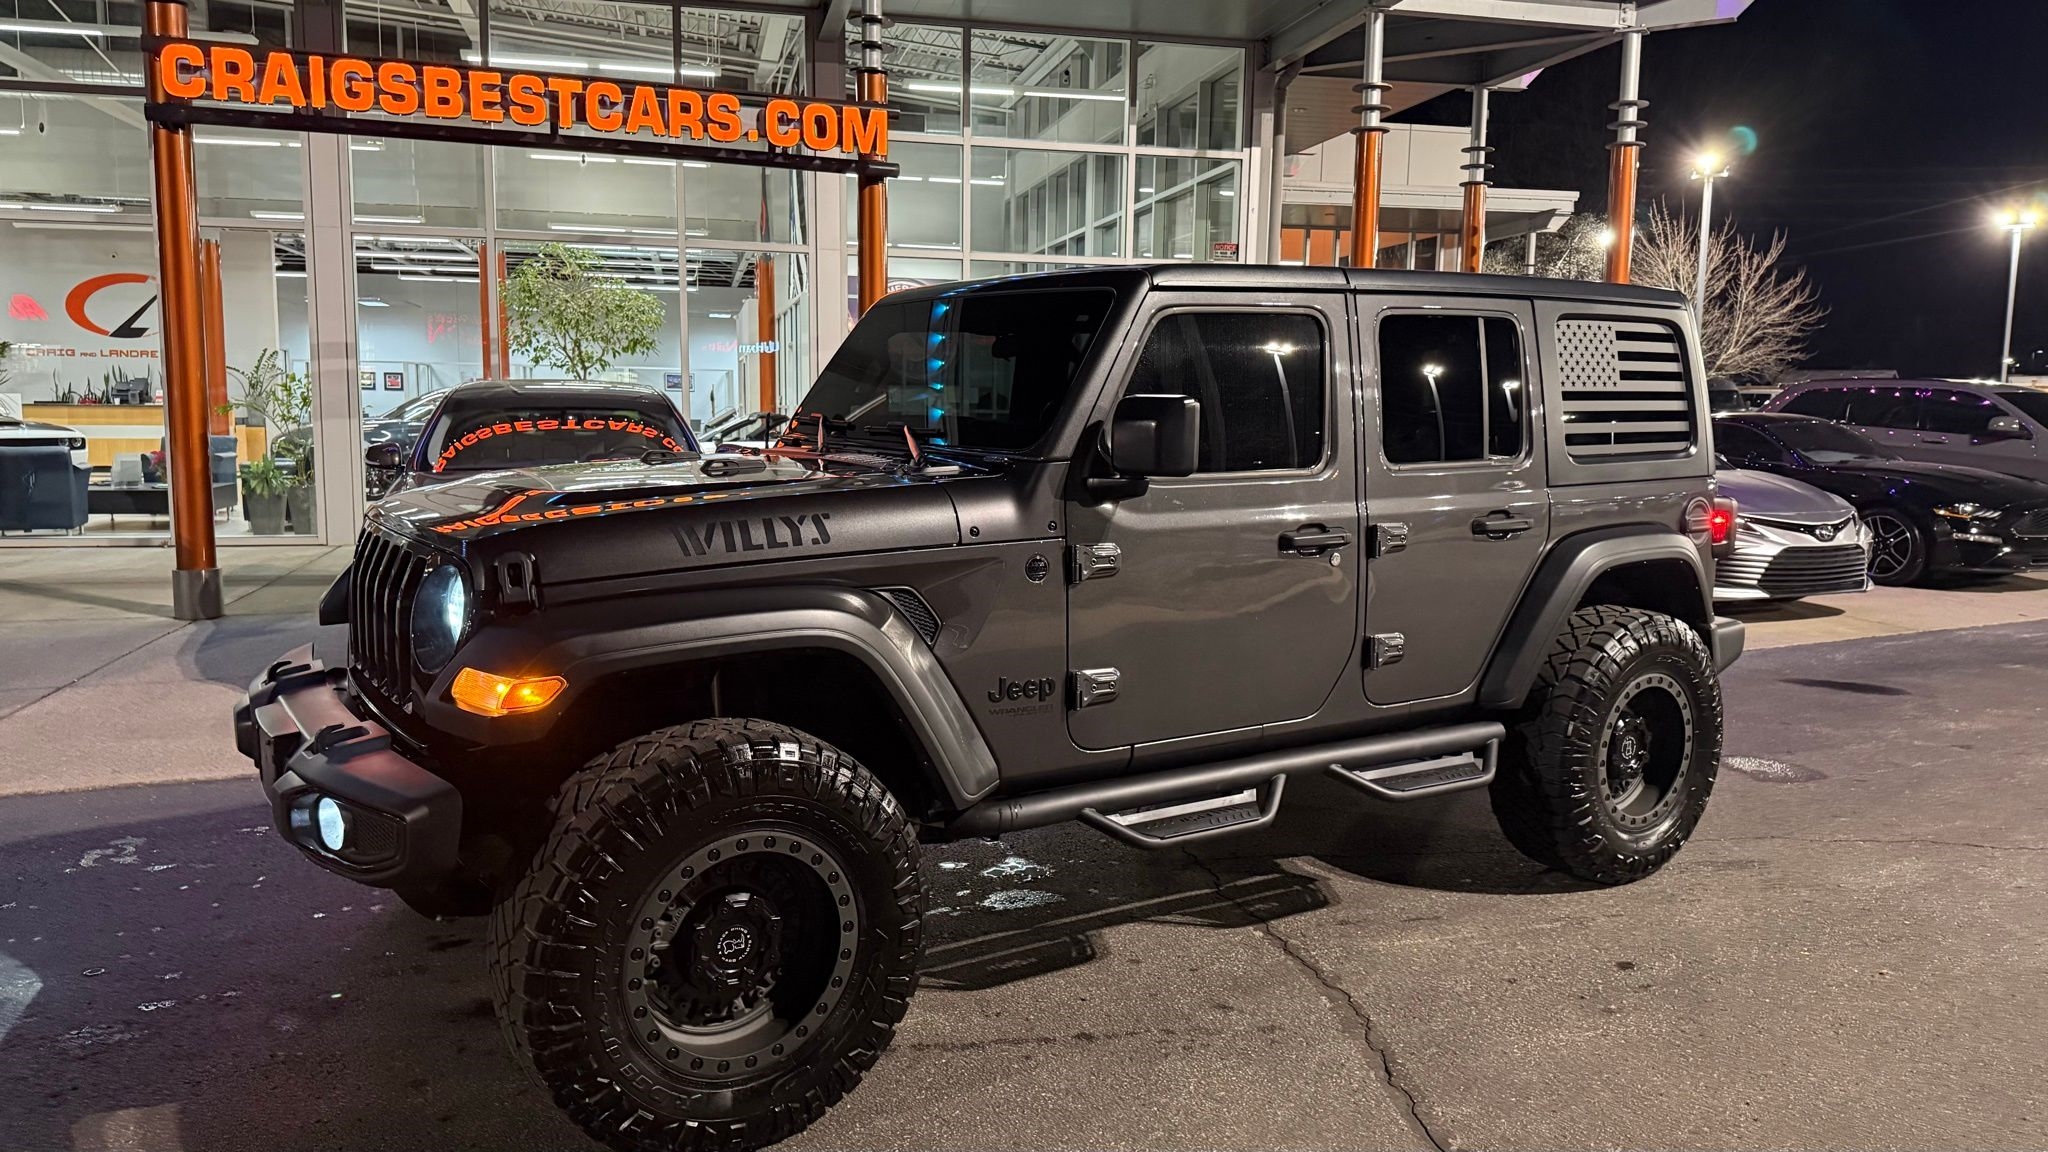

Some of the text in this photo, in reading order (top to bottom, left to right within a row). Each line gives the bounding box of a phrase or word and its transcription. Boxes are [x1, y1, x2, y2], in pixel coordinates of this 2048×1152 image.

[159, 42, 888, 157] CRAIGSBESTCARS.COM
[100, 349, 159, 358] LANDRE
[669, 512, 831, 557] WILLYS
[987, 676, 1056, 703] Jeep
